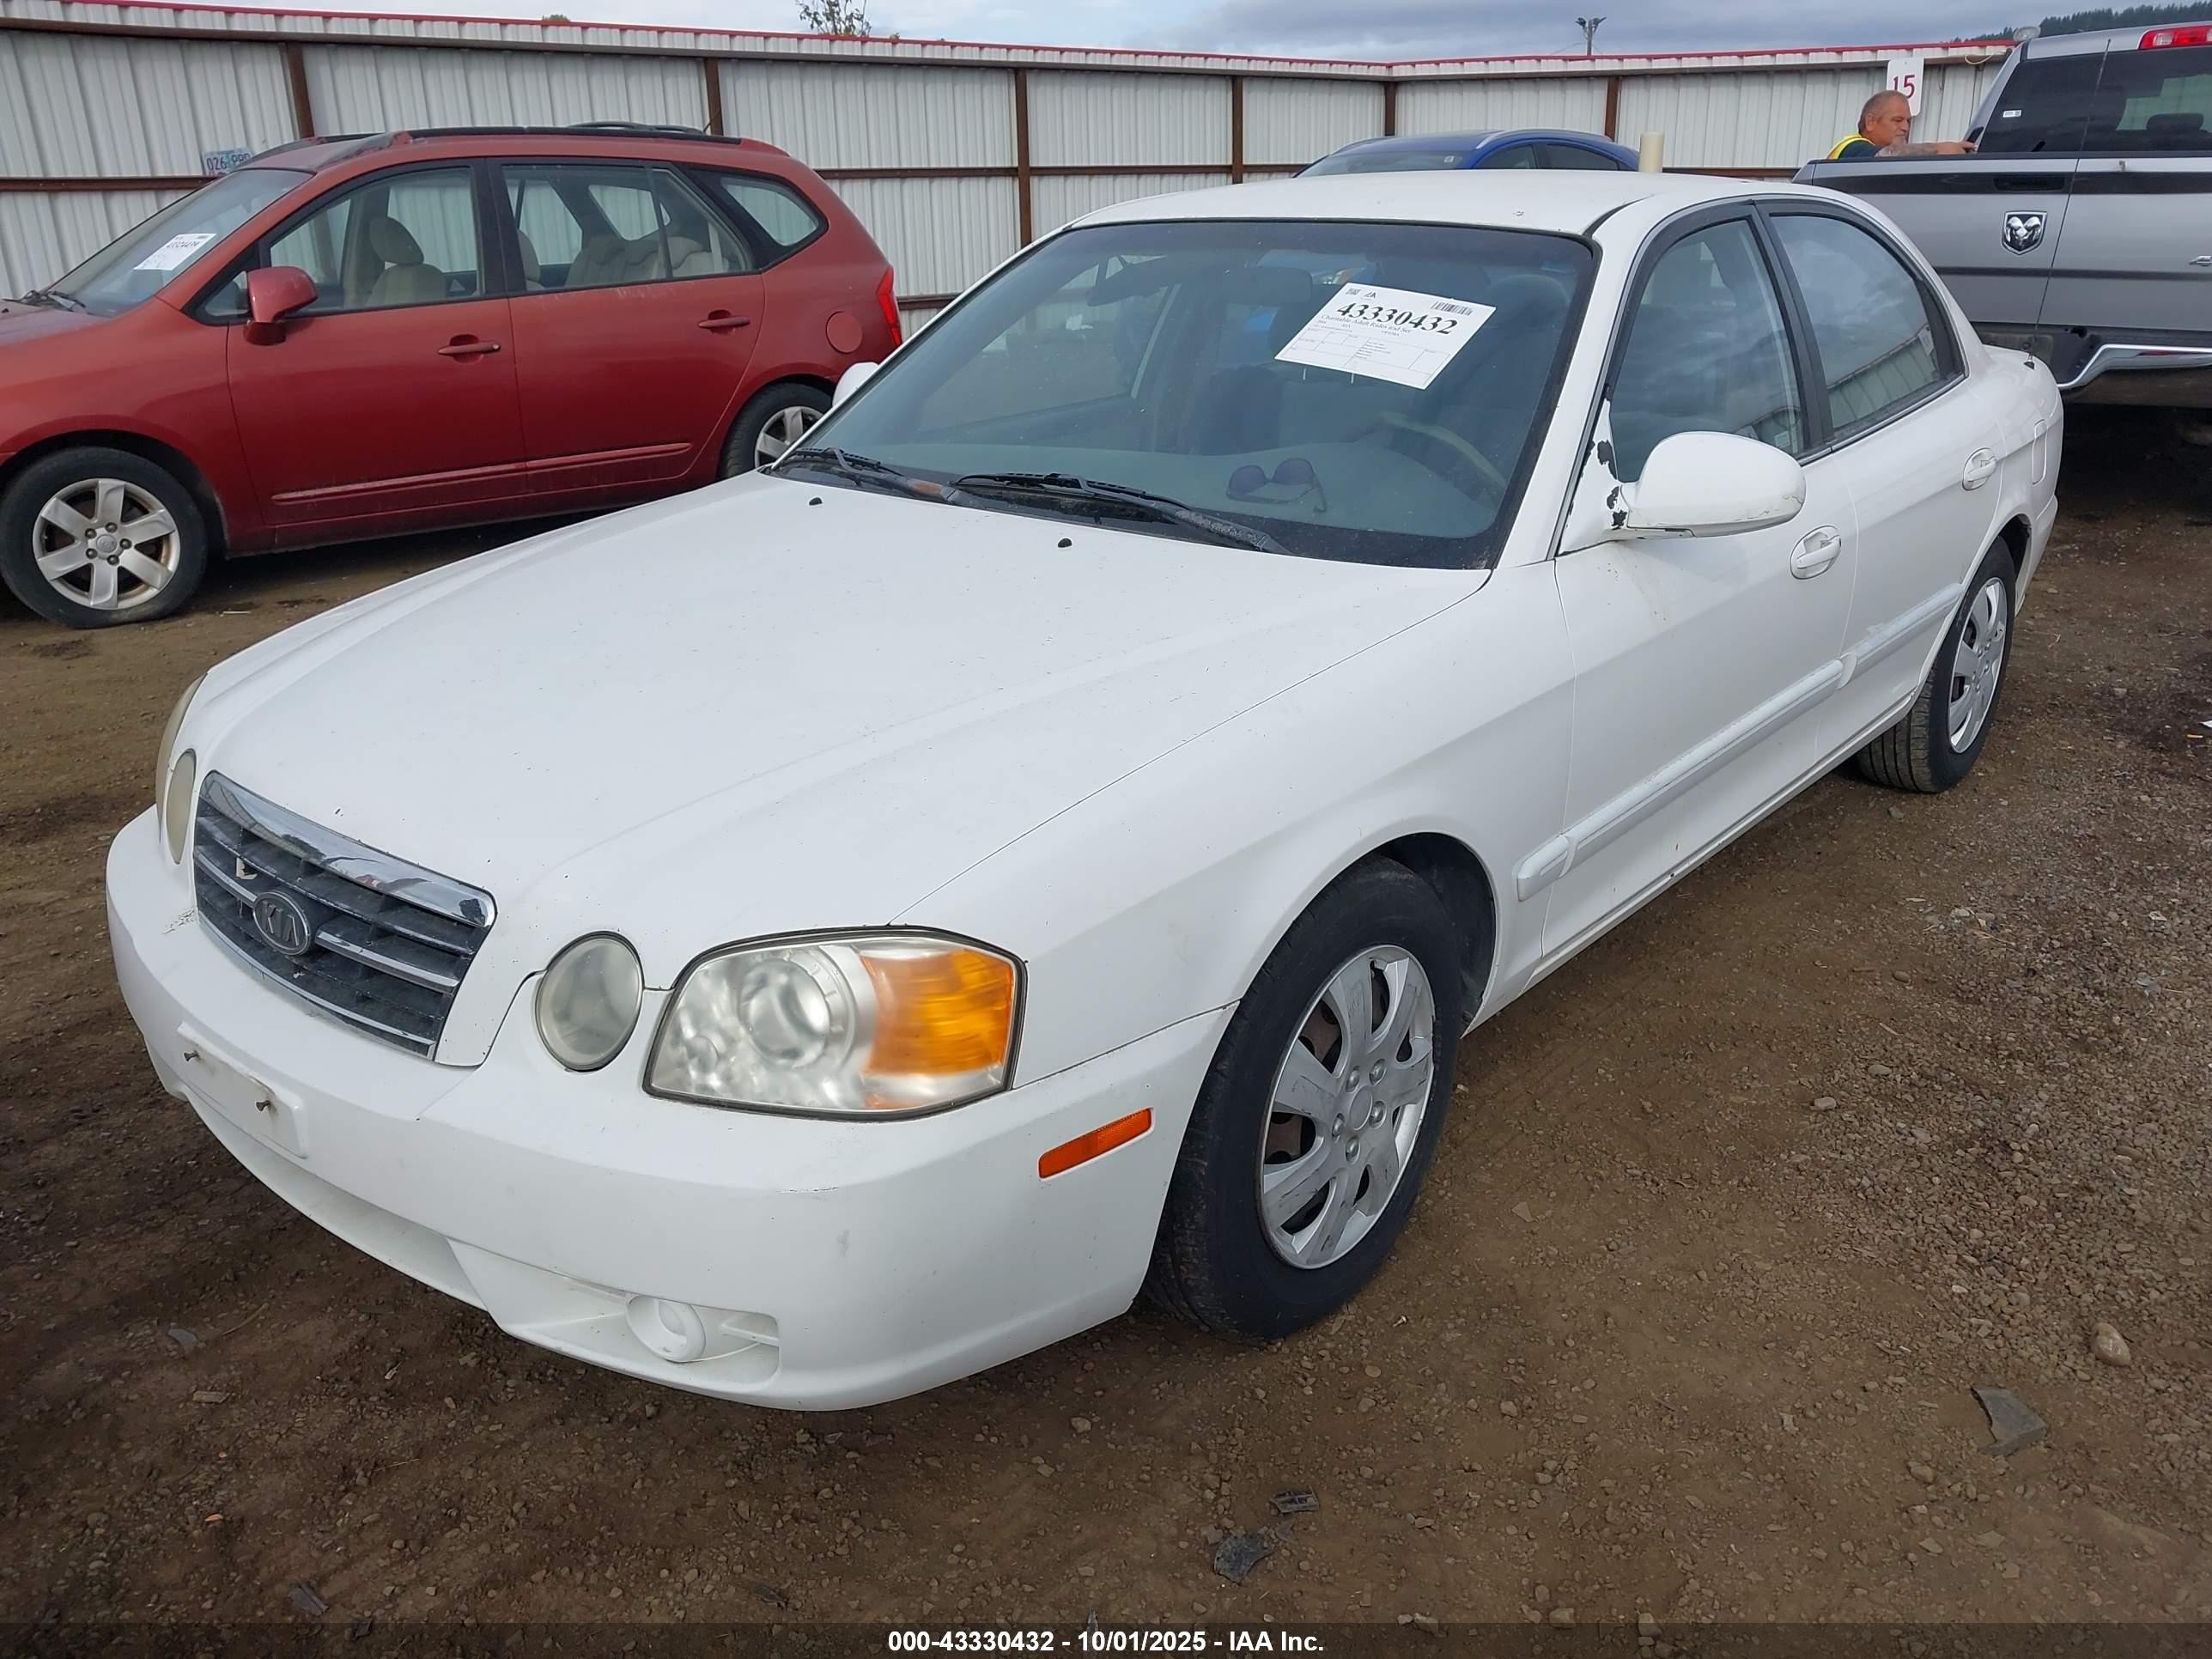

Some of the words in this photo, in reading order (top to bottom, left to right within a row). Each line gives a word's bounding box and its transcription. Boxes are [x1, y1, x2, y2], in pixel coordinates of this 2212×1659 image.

[1893, 74, 1915, 99] 15
[206, 156, 228, 171] 026
[1337, 302, 1458, 336] 43330432
[261, 900, 301, 947] KIA
